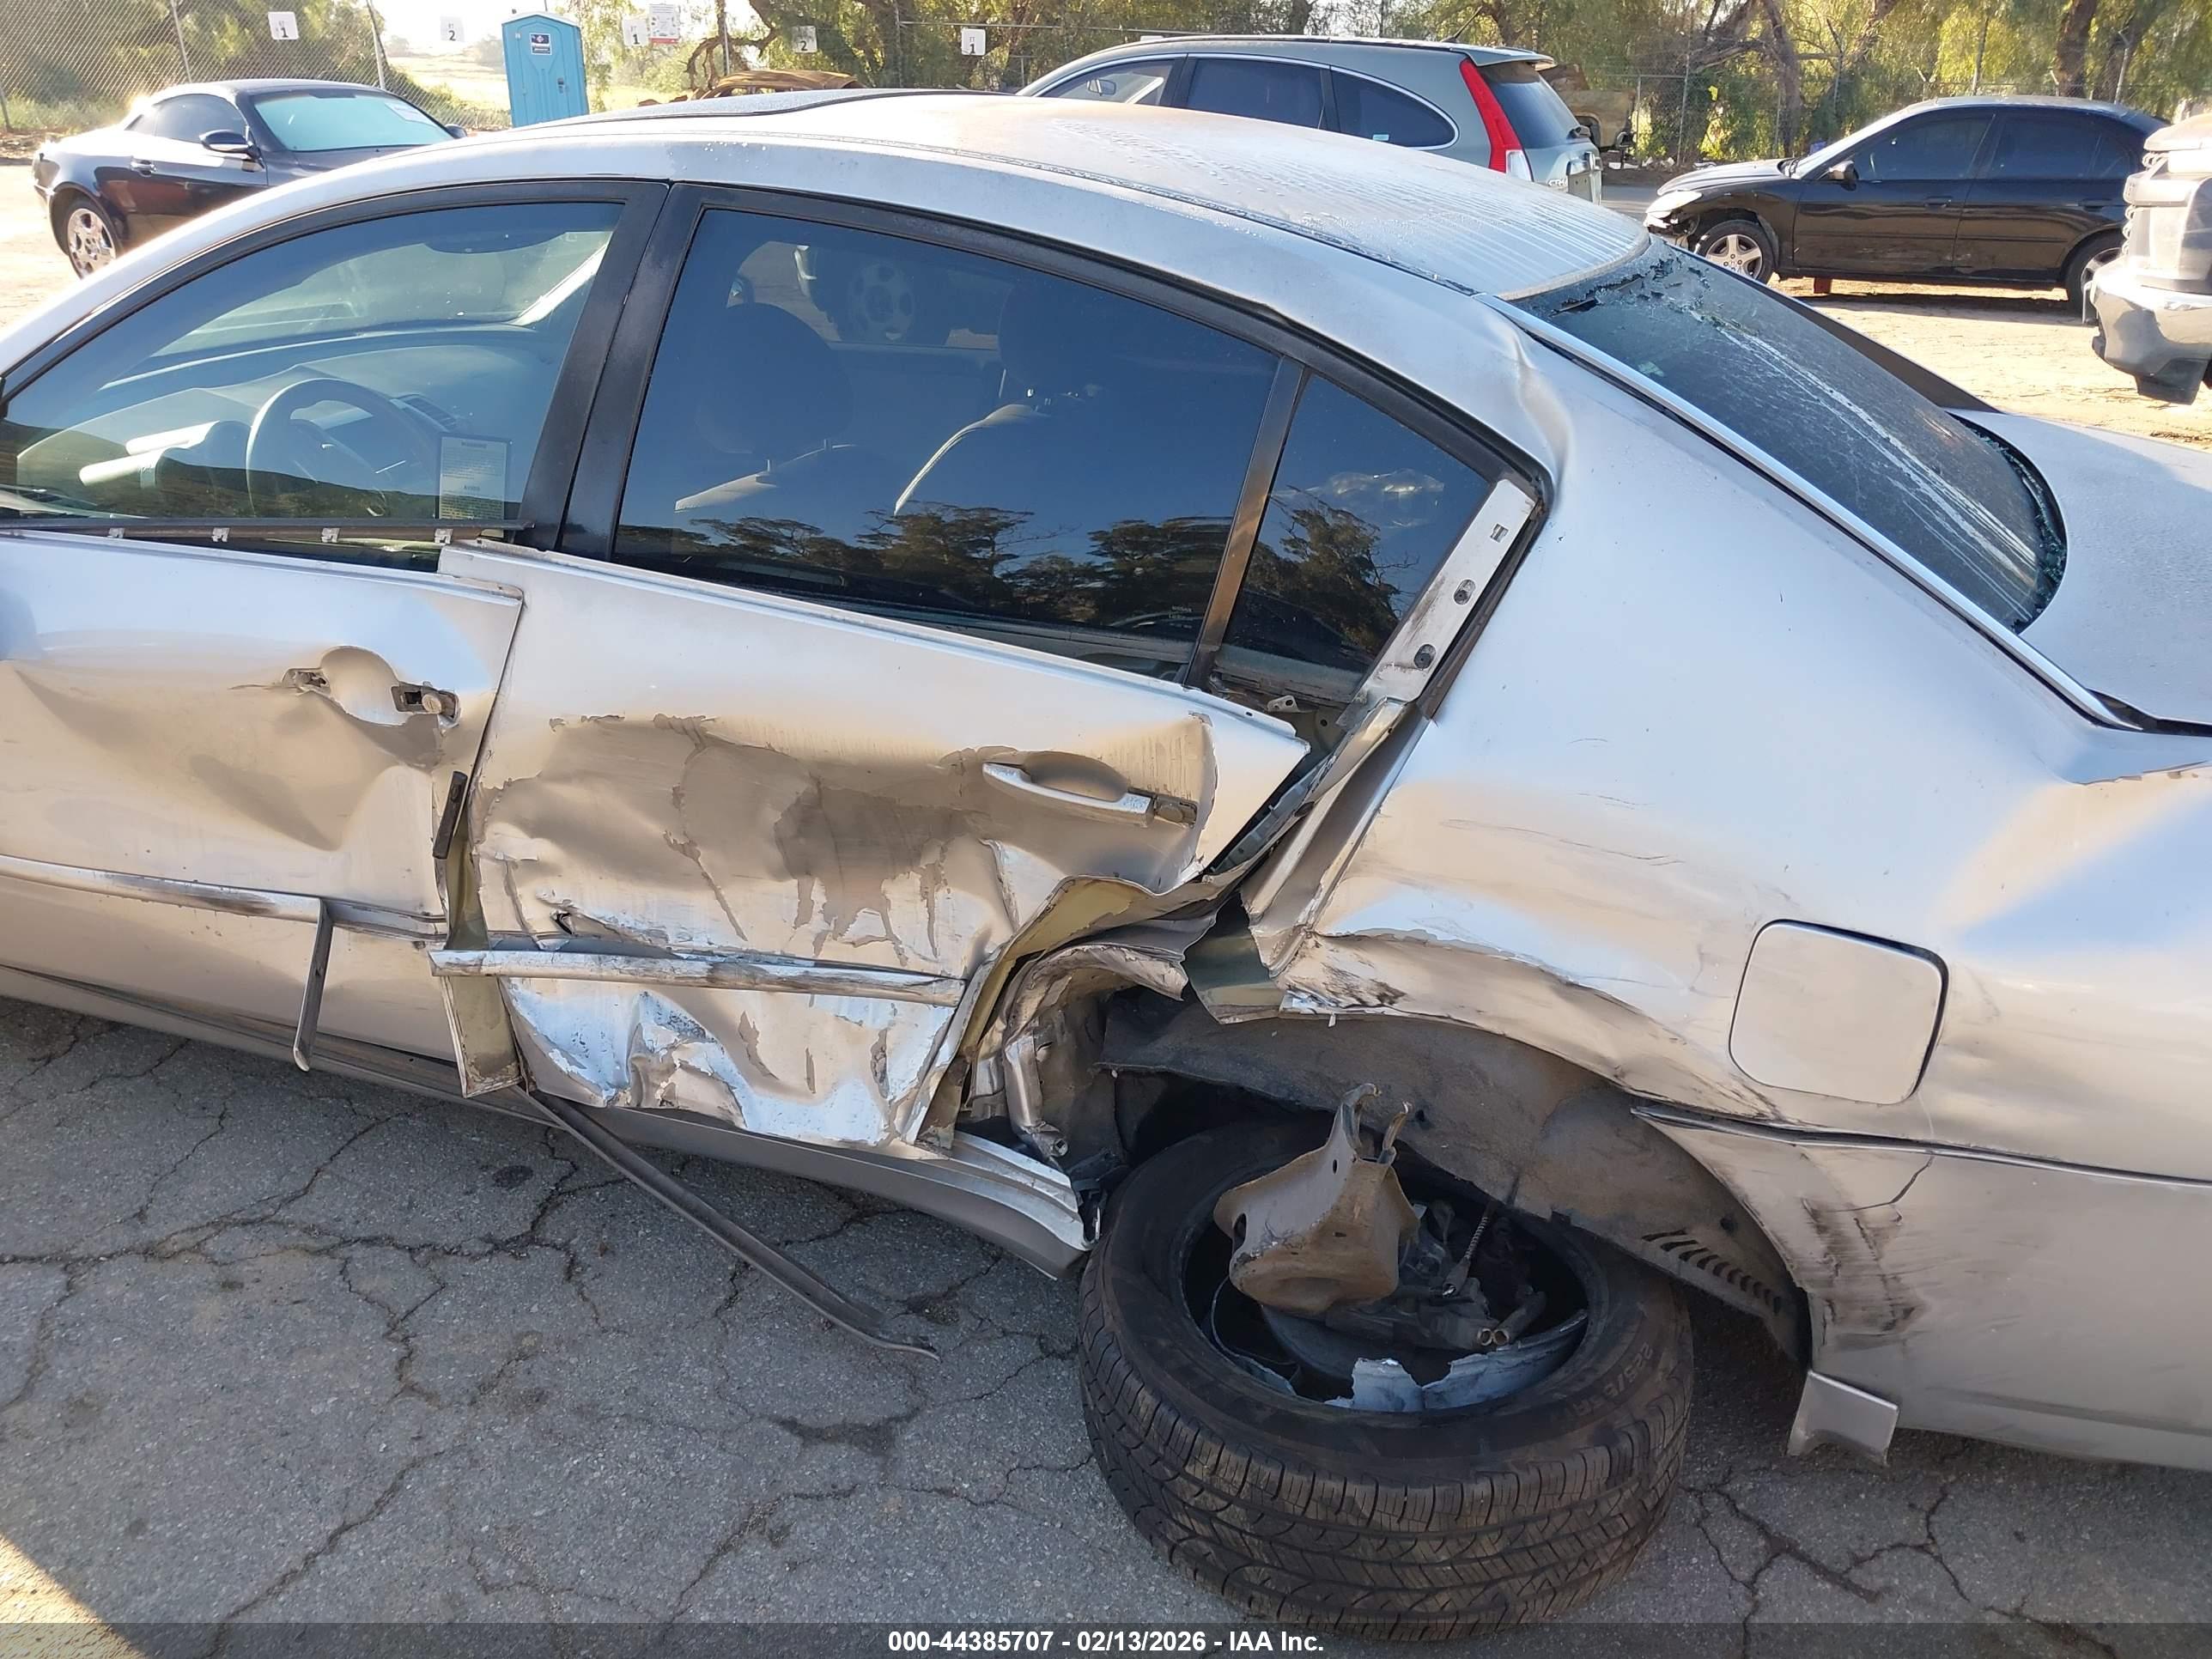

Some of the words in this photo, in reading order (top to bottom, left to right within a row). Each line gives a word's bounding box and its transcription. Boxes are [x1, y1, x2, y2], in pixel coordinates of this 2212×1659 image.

[281, 27, 289, 38] 1
[448, 30, 456, 41] 2
[632, 34, 641, 44] 1
[799, 40, 808, 51] 2
[969, 43, 975, 54] 1
